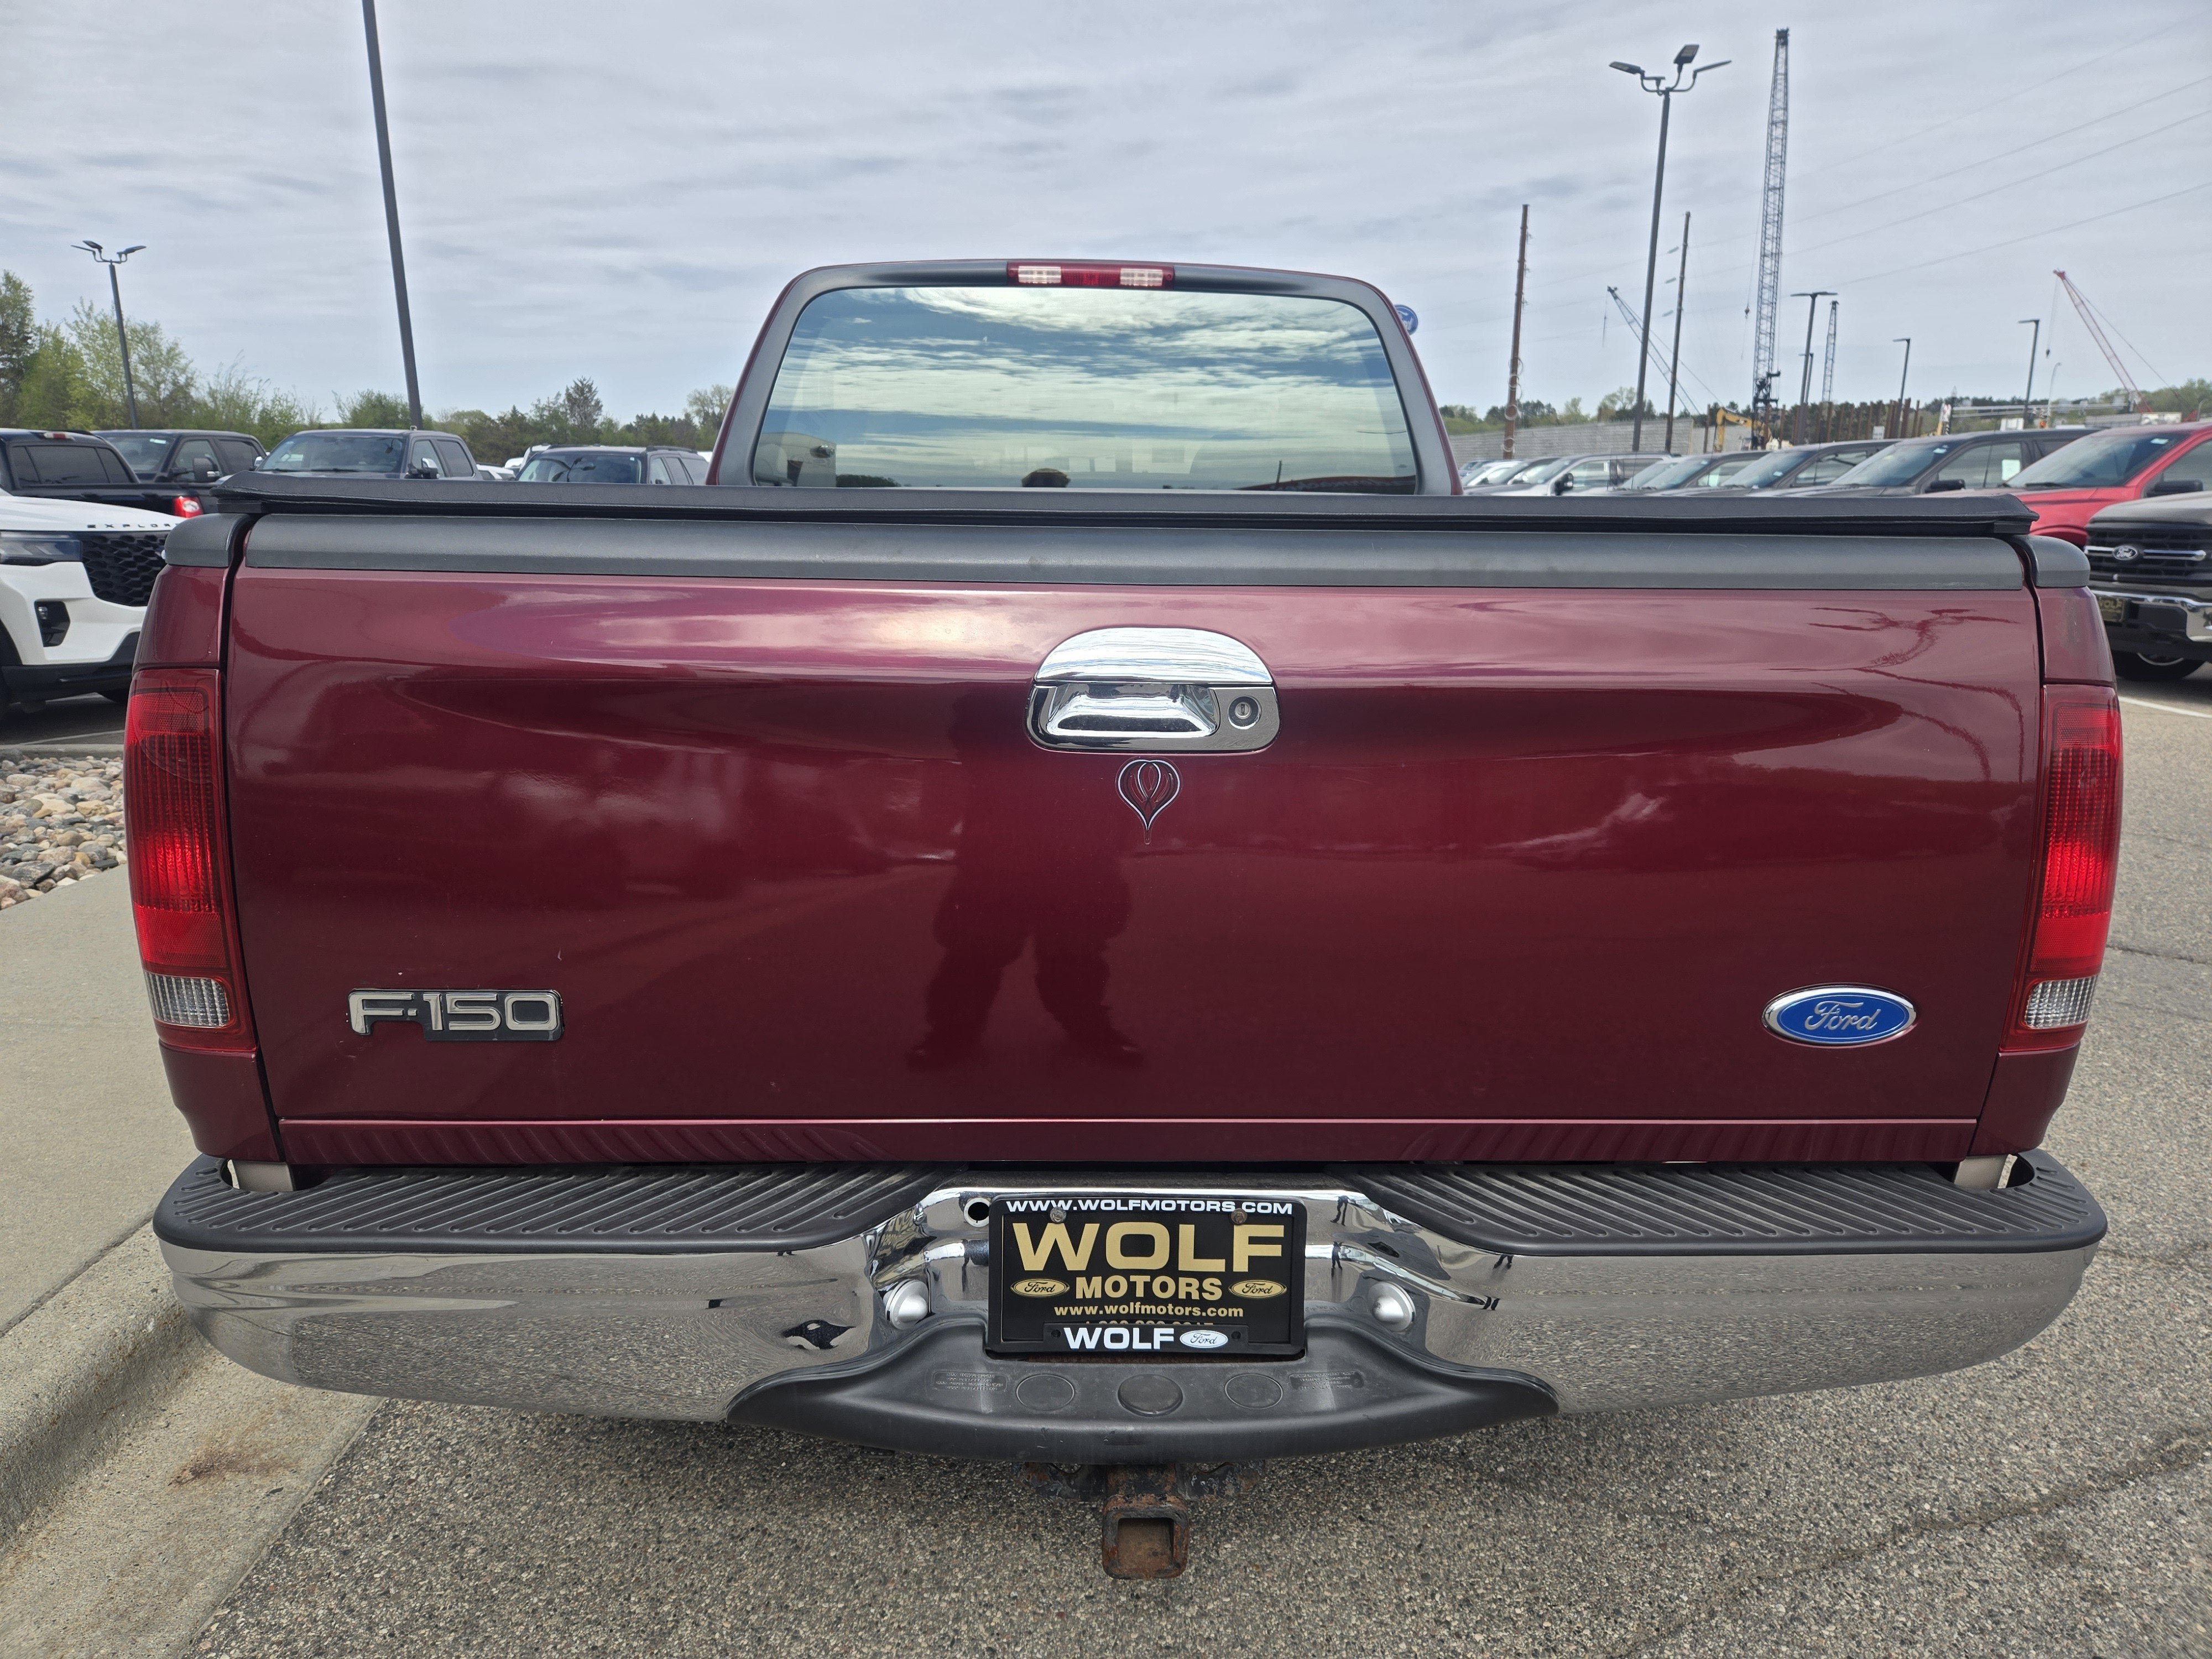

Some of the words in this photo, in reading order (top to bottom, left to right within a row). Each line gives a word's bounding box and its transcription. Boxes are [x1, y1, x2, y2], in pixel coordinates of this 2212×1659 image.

[349, 992, 559, 1034] F-150
[1804, 1000, 1881, 1030] Ford
[1006, 1199, 1293, 1215] WWW.WOLFMOTORSCOM
[1012, 1222, 1285, 1272] WOLF
[1024, 1281, 1056, 1293] Ford
[1076, 1275, 1222, 1301] MOTORS
[1241, 1282, 1273, 1295] Ford
[1054, 1301, 1243, 1317] www.wolfmotors.com
[1063, 1327, 1175, 1350] WOLF
[1190, 1332, 1217, 1344] Ford
